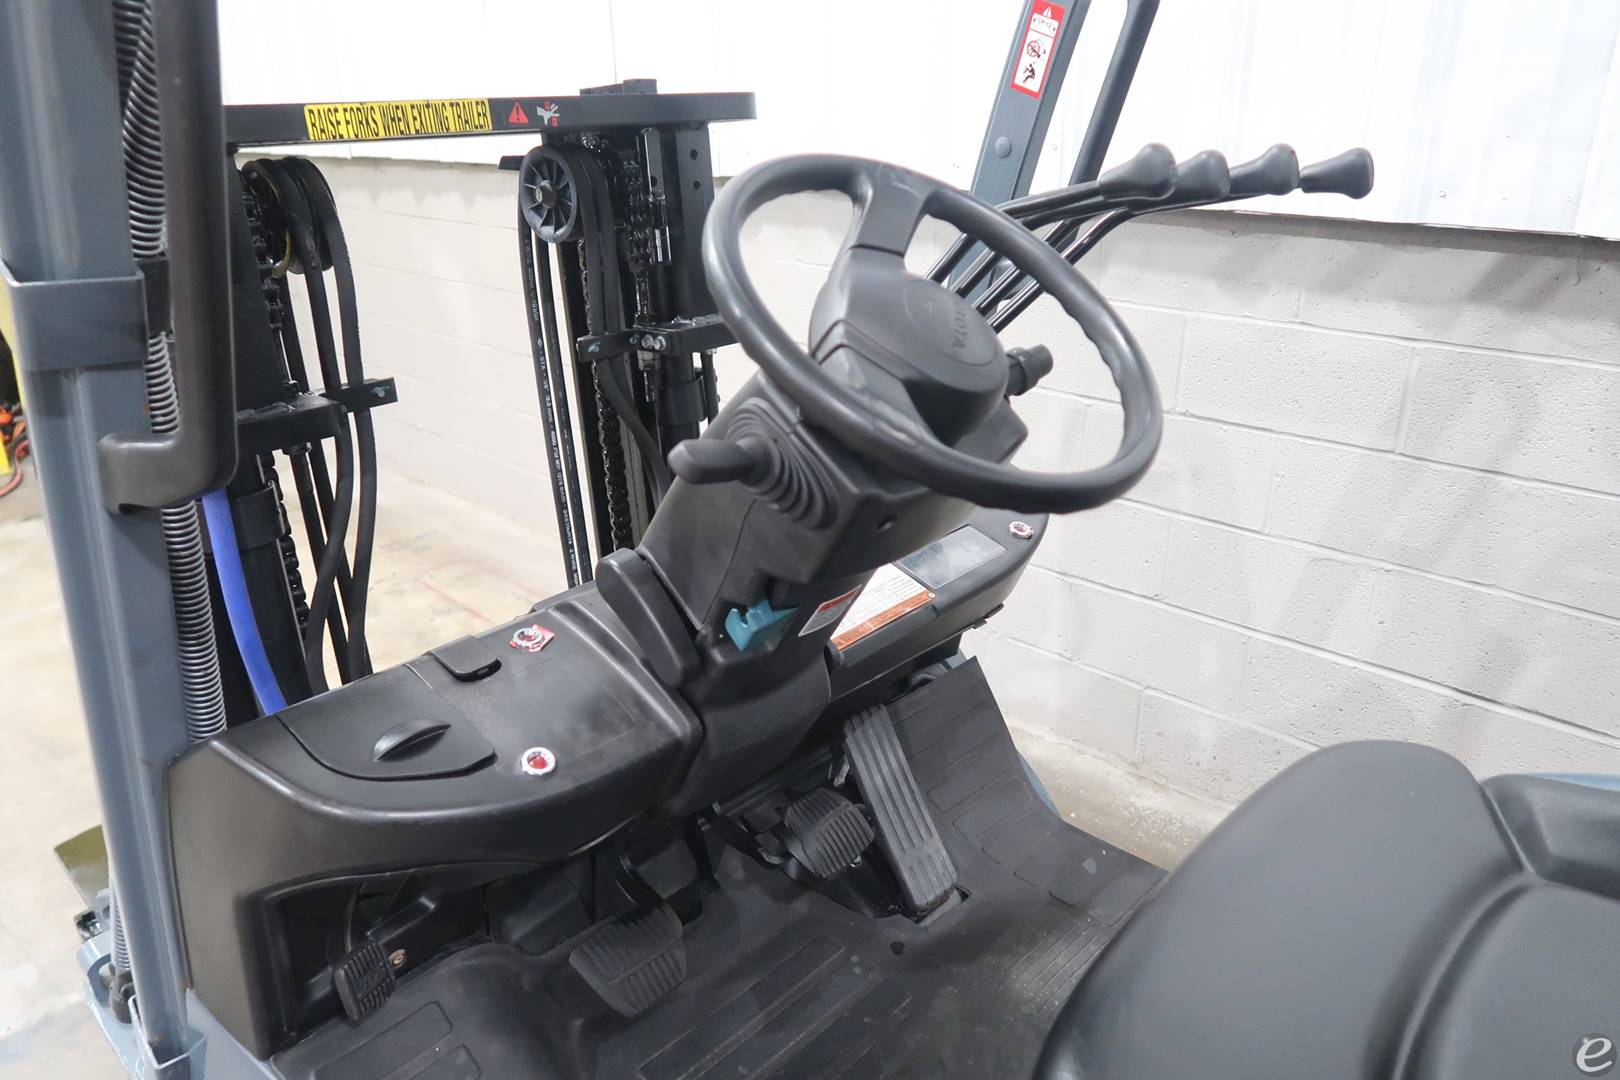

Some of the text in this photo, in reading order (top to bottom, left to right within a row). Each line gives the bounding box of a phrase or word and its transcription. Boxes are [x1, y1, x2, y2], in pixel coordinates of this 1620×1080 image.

[308, 100, 490, 141] RAISE FORKS WHEN EXITING TRAILER
